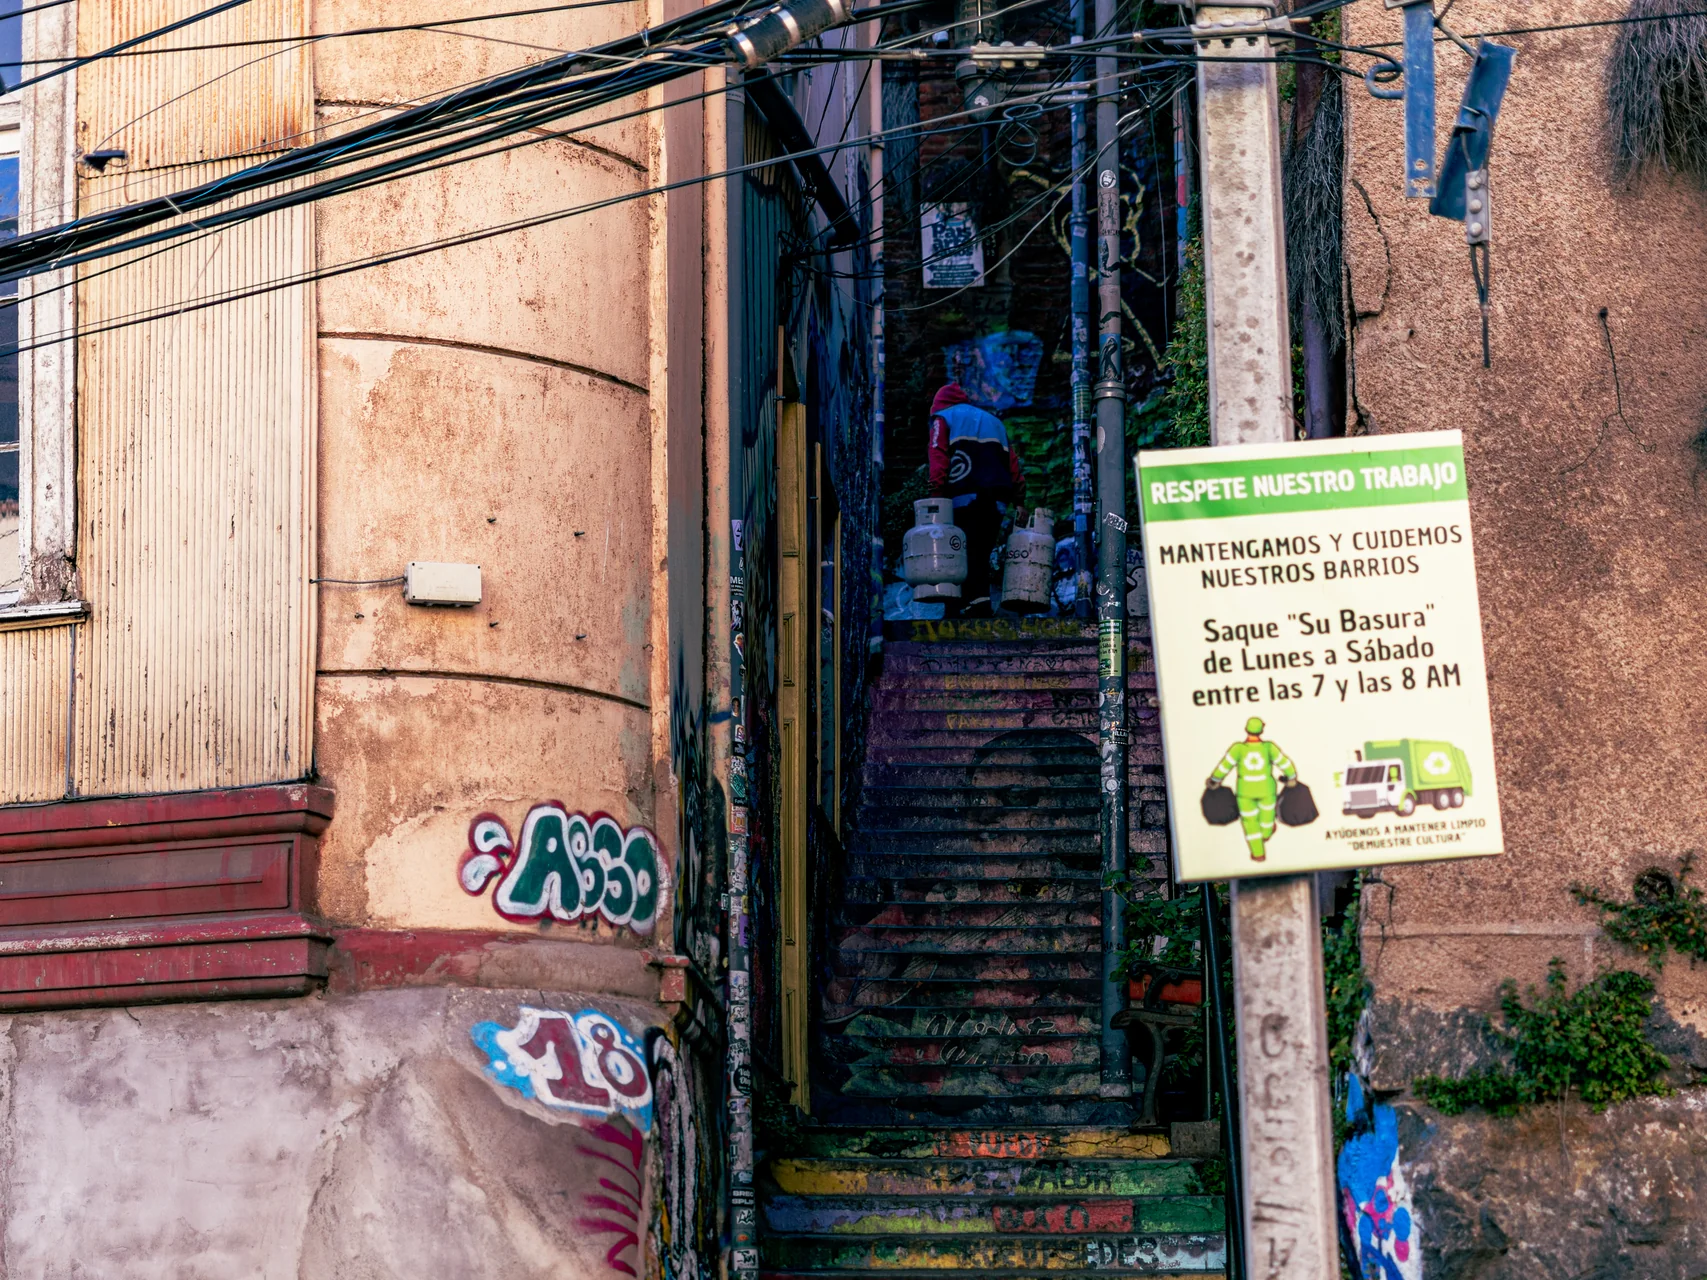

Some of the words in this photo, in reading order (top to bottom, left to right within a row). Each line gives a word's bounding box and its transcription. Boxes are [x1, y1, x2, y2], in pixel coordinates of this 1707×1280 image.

[1150, 476, 1248, 505] RESPETE
[1252, 468, 1356, 498] NUESTRO
[1359, 460, 1458, 491] TRABAJO
[1159, 535, 1321, 565] MANTENGAMOS
[1329, 533, 1342, 552] Y
[1352, 525, 1462, 551] CUIDEMOS
[1201, 562, 1315, 589] NUESTROS
[1323, 555, 1419, 580] BARRIOS
[1203, 618, 1279, 647] Saque
[1287, 612, 1331, 636] "Su
[1339, 603, 1434, 633] Basura"
[1203, 650, 1233, 675] de
[1241, 648, 1315, 671] Lunes
[1324, 649, 1337, 665] a
[1346, 635, 1434, 663] Sábado
[1192, 685, 1260, 707] entre
[1268, 677, 1303, 701] las
[1312, 673, 1325, 697] 7
[1335, 679, 1348, 702] y
[1358, 670, 1392, 694] las
[1401, 666, 1416, 690] 8
[1427, 663, 1461, 689] AM
